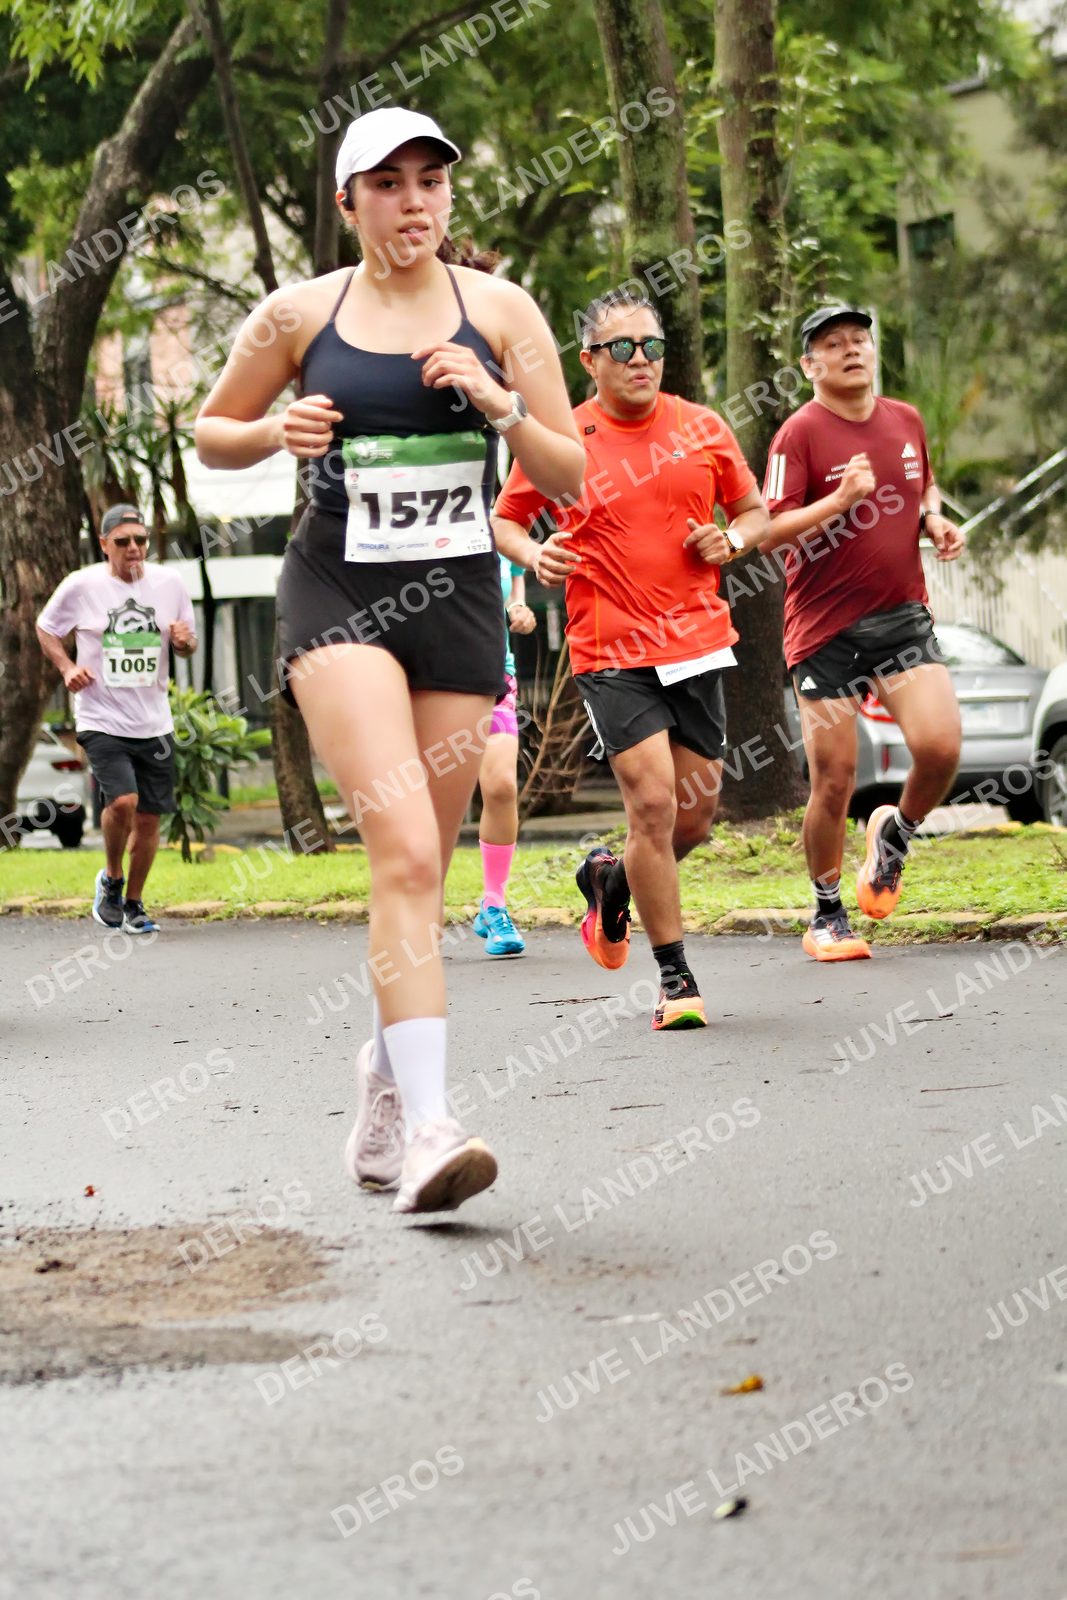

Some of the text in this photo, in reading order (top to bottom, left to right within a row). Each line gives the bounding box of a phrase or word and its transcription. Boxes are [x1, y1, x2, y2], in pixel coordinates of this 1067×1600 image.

[360, 486, 476, 530] 1572
[467, 543, 487, 552] 1572
[109, 657, 157, 673] 1005
